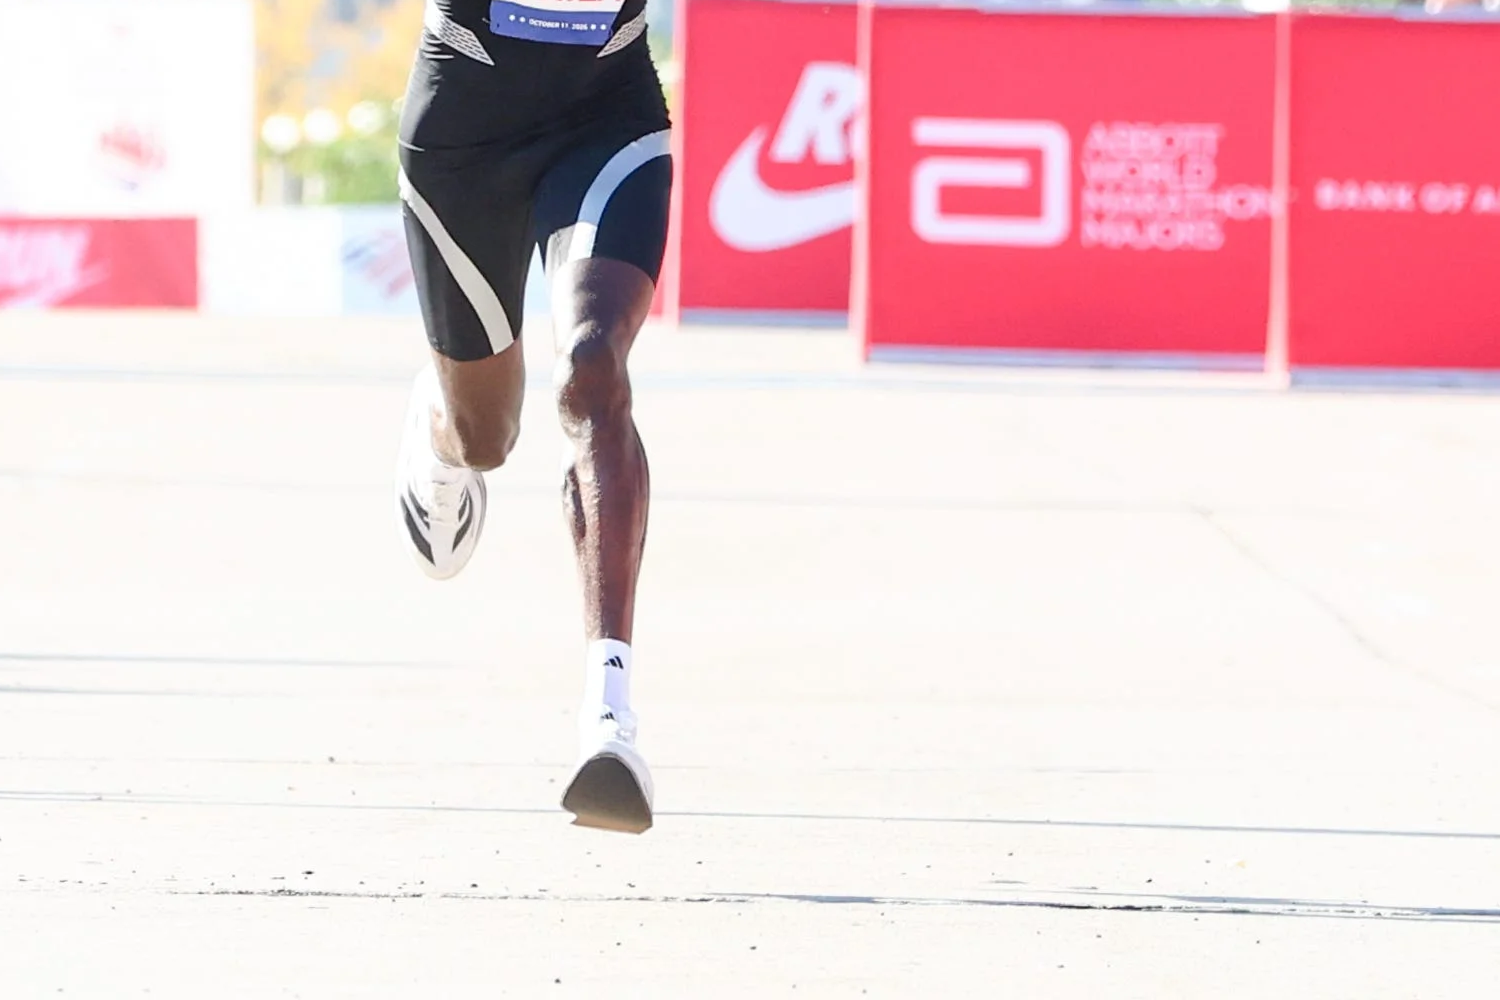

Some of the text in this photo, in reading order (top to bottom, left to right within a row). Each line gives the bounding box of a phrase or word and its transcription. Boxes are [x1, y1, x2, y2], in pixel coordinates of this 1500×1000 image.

[529, 18, 560, 29] OCTOBER
[1082, 121, 1225, 157] ABBOTT
[1080, 156, 1216, 189] WORLD
[1315, 178, 1415, 212] BANK
[1419, 181, 1469, 215] OF
[1081, 218, 1225, 250] MAJORS
